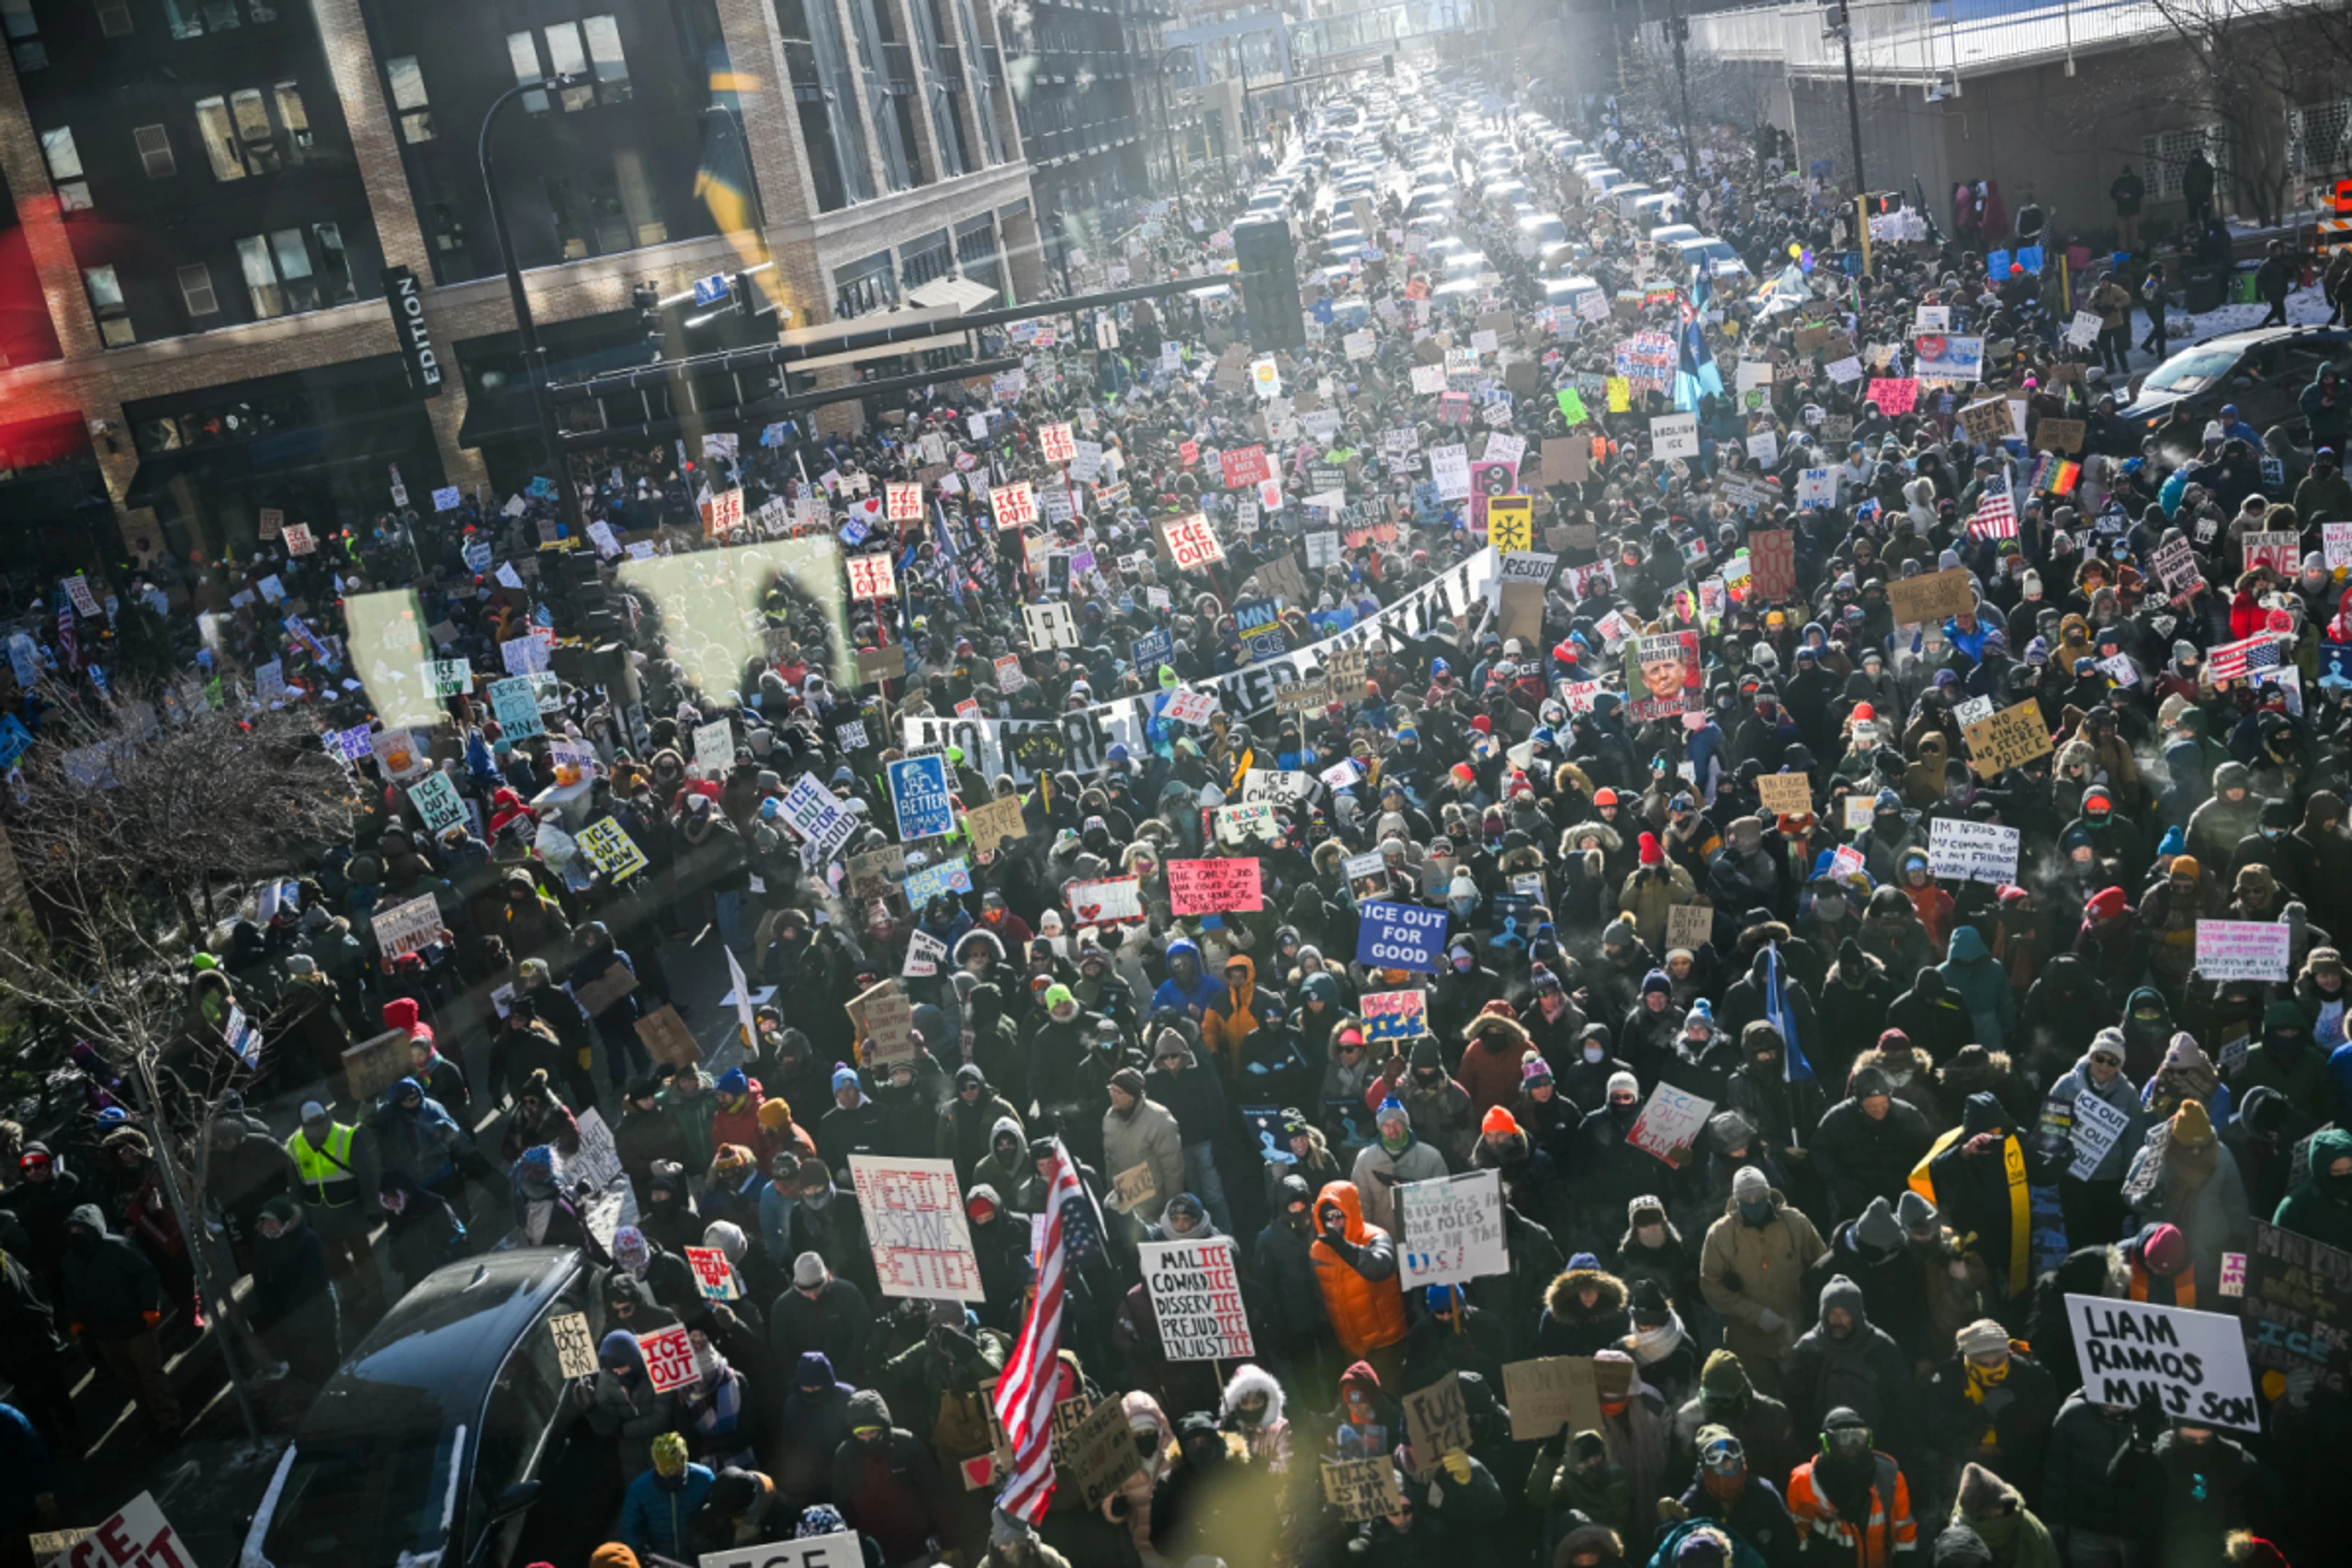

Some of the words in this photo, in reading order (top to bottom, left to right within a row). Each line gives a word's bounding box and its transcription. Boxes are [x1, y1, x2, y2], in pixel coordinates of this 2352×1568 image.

[398, 278, 440, 384] EDITION
[1635, 331, 1670, 344] TRUMP
[1636, 344, 1667, 354] CAN'T
[1631, 365, 1666, 378] STATE
[1965, 400, 2007, 420] FUCK
[1042, 429, 1070, 446] ICE
[1653, 423, 1696, 439] ABOLISH
[1967, 419, 1993, 434] ICE
[1046, 445, 1074, 460] OUT!
[1666, 439, 1684, 449] ICE
[1806, 468, 1827, 480] MN
[715, 500, 740, 517] ICE
[889, 491, 918, 504] ICE
[995, 490, 1028, 511] ICE
[1363, 498, 1385, 517] OUT
[714, 512, 741, 528] OUT!
[889, 505, 920, 519] OUT!
[999, 505, 1033, 525] OUT!
[1168, 523, 1207, 548] ICE
[1750, 529, 1793, 552] ICE
[1177, 541, 1216, 565] OUT!
[2155, 540, 2188, 562] JAIL
[2245, 545, 2300, 577] LOVE
[853, 560, 886, 578] ICE
[1504, 557, 1555, 580] RESIST
[1749, 553, 1792, 578] OUT
[2161, 553, 2192, 577] ROSS
[854, 578, 892, 595] OUT!
[1236, 604, 1275, 631] MN
[1244, 632, 1284, 657] ICE
[1635, 648, 1666, 661] ORDERS
[1641, 639, 1657, 651] ICE
[433, 661, 454, 675] ICE
[1333, 652, 1363, 673] ICE
[435, 680, 464, 695] NOW
[1331, 674, 1364, 695] OUT
[1177, 693, 1212, 710] ICE
[1962, 700, 1984, 716] GO
[503, 720, 534, 739] MN
[1989, 718, 2030, 743] KINGS
[1991, 713, 2011, 728] NO
[1018, 738, 1037, 758] ICE
[1043, 737, 1065, 758] OUT
[1975, 744, 1993, 761] NO
[1996, 724, 2047, 752] SECRET
[1996, 738, 2045, 769] POLICE
[416, 779, 441, 800] ICE
[1262, 773, 1289, 788] ICE
[424, 792, 449, 814] OUT
[785, 779, 815, 814] ICE
[900, 793, 949, 818] BETTER
[431, 805, 461, 828] NOW
[796, 789, 828, 829] OUT
[972, 801, 1016, 830] STOP
[1225, 809, 1269, 827] ABOLISH
[808, 804, 841, 840] FOR
[901, 812, 946, 834] HUMANS
[978, 815, 1019, 842] HATE
[1236, 820, 1265, 837] ICE
[1959, 822, 1996, 836] AFRAID
[2003, 829, 2018, 840] ON
[585, 822, 614, 845] ICE
[594, 837, 623, 860] OUT
[604, 845, 634, 874] NOW
[874, 848, 899, 865] OUT
[907, 860, 966, 889] JUSTICE
[1169, 872, 1192, 886] THE
[911, 878, 942, 897] FOR
[1364, 905, 1398, 924] ICE
[1402, 909, 1446, 931] OUT
[384, 919, 444, 957] HUMANS
[1382, 925, 1422, 944] FOR
[1372, 942, 1429, 964] GOOD
[876, 1002, 897, 1015] STOP
[880, 1030, 898, 1043] OUR
[1663, 1088, 1698, 1112] ICE
[2078, 1093, 2098, 1112] ICE
[2099, 1104, 2126, 1129] OUT
[1653, 1103, 1695, 1125] OUT
[1643, 1127, 1678, 1155] MN
[2085, 1126, 2112, 1148] OUT
[1405, 1194, 1478, 1220] BELONGS
[862, 1208, 974, 1251] DESERVES
[1437, 1210, 1484, 1232] POLES
[1407, 1235, 1440, 1252] NOT
[1443, 1231, 1464, 1249] IN
[2256, 1224, 2304, 1266] MN
[1161, 1245, 1231, 1269] MALICE
[871, 1247, 984, 1292] BETTER
[1152, 1269, 1236, 1293] COWARDICE
[1156, 1292, 1242, 1315] DISSERVICE
[554, 1314, 581, 1332] ICE
[1161, 1313, 1248, 1338] PREJUDICE
[2085, 1305, 2180, 1348] LIAM
[557, 1328, 586, 1352] OUT
[641, 1328, 691, 1365] ICE
[1163, 1335, 1253, 1359] INJUSTICE
[2257, 1317, 2331, 1364] ICE
[2312, 1320, 2350, 1353] FOR
[566, 1356, 594, 1376] MN
[649, 1354, 695, 1386] OUT
[2086, 1339, 2203, 1387] RAMOS
[1505, 1370, 1528, 1395] No
[1412, 1381, 1465, 1429] FUCK
[2104, 1378, 2191, 1416] MN'S
[2198, 1392, 2257, 1427] SON
[1066, 1407, 1118, 1455] Silence
[1327, 1461, 1381, 1484] THIS
